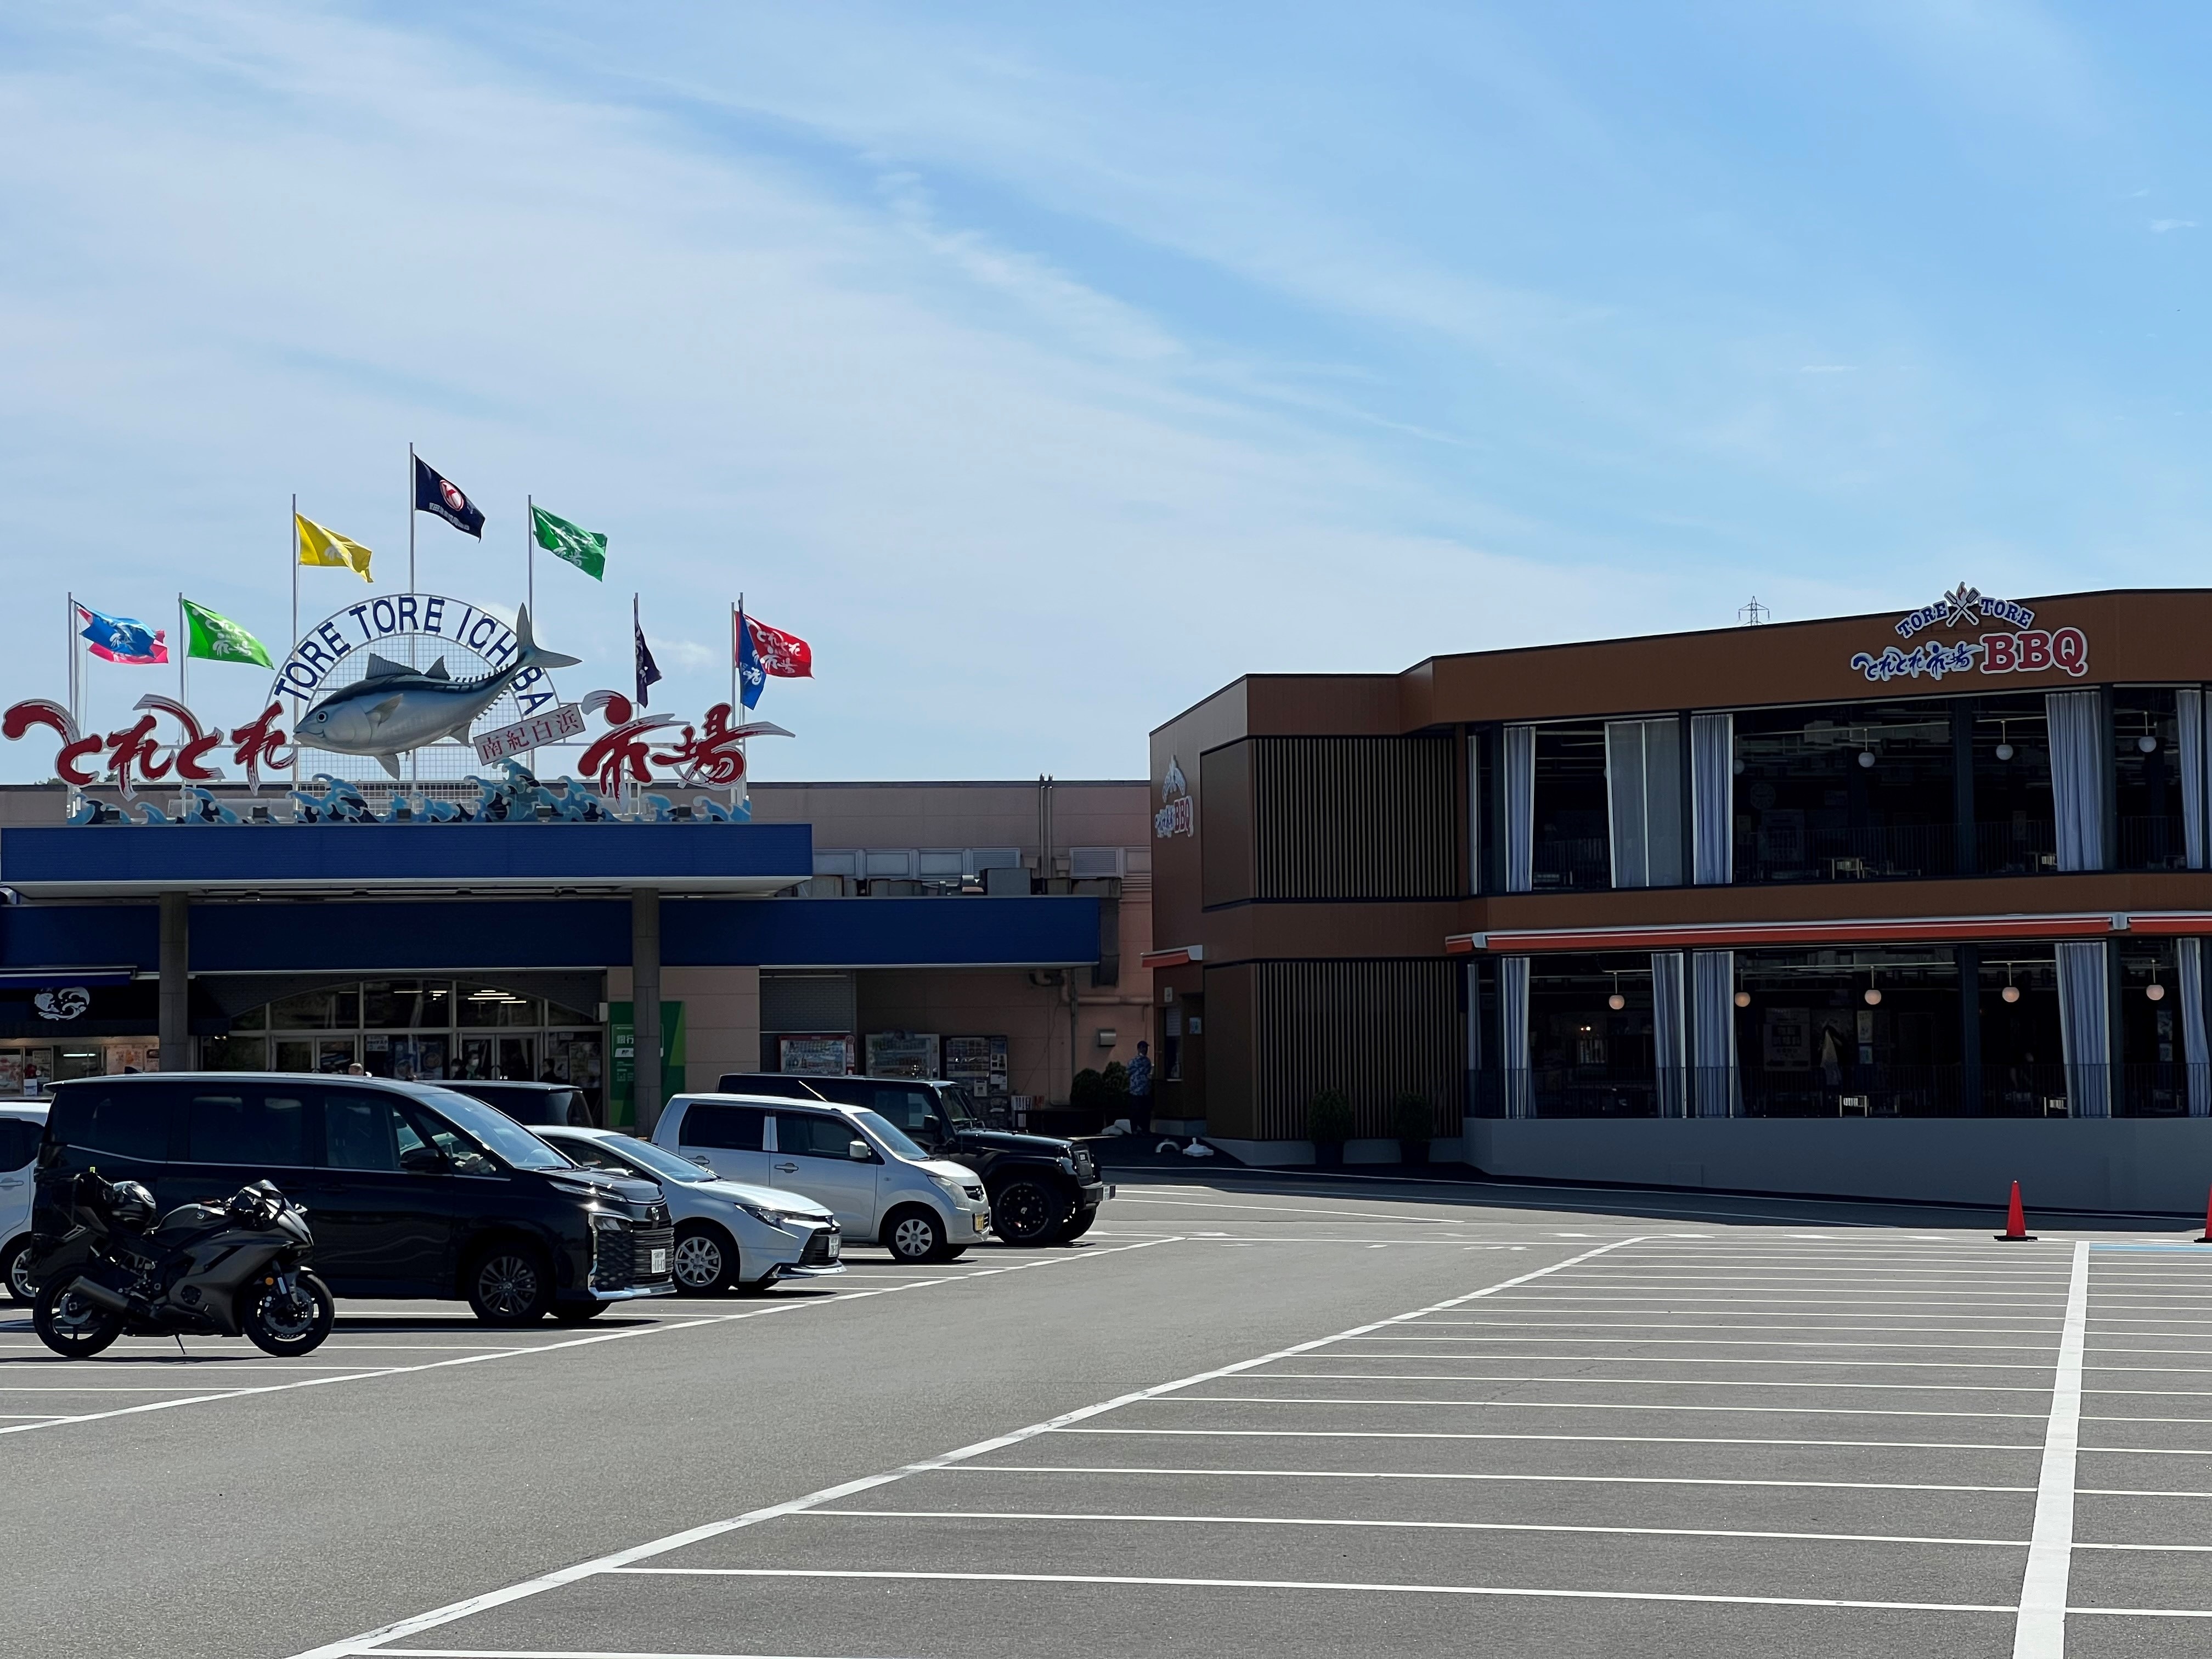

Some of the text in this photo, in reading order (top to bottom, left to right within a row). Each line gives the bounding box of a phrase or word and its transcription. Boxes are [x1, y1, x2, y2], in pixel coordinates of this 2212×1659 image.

[1897, 597, 2035, 638] TORE TORE
[274, 622, 351, 702] TORE
[349, 596, 445, 641] TORE
[456, 607, 554, 715] ICHBA
[1980, 627, 2088, 676] BBQ
[482, 710, 579, 760] 南紀白浜
[1175, 795, 1193, 837] BBQ
